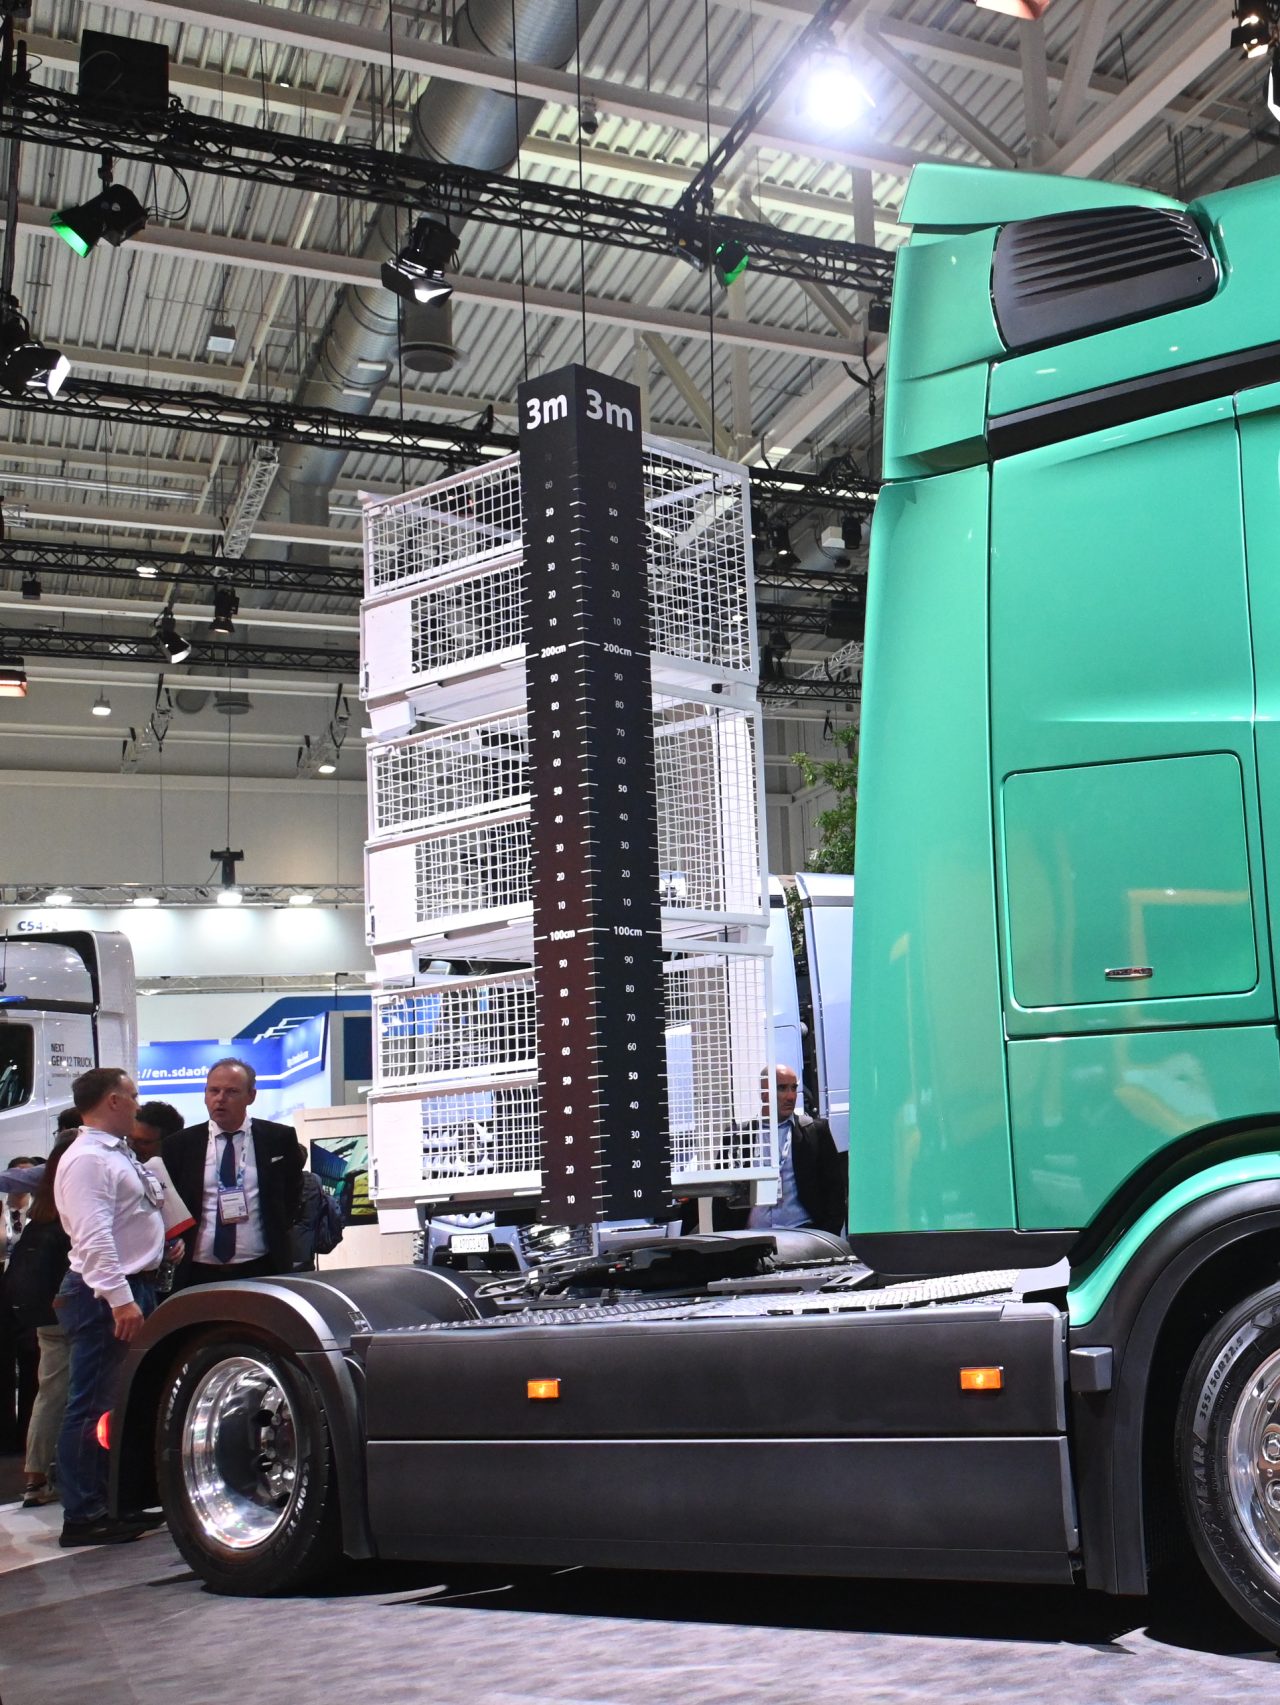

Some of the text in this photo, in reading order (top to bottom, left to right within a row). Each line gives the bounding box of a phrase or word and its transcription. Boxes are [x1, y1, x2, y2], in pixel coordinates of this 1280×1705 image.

[527, 395, 567, 429] 3m
[586, 389, 633, 431] 3m
[545, 507, 555, 518] 50
[608, 507, 618, 517] 50
[546, 534, 555, 544] 40
[609, 535, 619, 544] 40
[547, 562, 556, 572] 30
[610, 561, 620, 572] 30
[547, 589, 557, 600] 20
[611, 589, 621, 599] 20
[548, 617, 558, 627] 10
[612, 617, 622, 627] 10
[541, 645, 566, 658] 200cm
[604, 643, 632, 656] 200cm
[549, 673, 559, 683] 90
[613, 672, 624, 682] 90
[550, 701, 560, 711] 80
[614, 699, 625, 710] 80
[551, 729, 561, 739] 70
[616, 727, 626, 737] 70
[552, 757, 562, 768] 60
[616, 756, 627, 765] 60
[553, 785, 563, 796] 50
[617, 784, 628, 793] 50
[554, 814, 564, 824] 40
[618, 812, 629, 822] 40
[555, 843, 565, 853] 30
[620, 840, 630, 850] 30
[556, 871, 566, 882] 20
[621, 869, 631, 878] 20
[557, 900, 566, 910] 10
[622, 897, 632, 907] 10
[550, 930, 575, 941] 100cm
[614, 926, 642, 936] 100cm
[558, 958, 568, 969] 90
[624, 955, 634, 965] 90
[559, 987, 569, 998] 80
[625, 984, 635, 993] 80
[560, 1017, 570, 1027] 70
[626, 1013, 636, 1022] 70
[561, 1046, 571, 1056] 60
[627, 1042, 637, 1051] 60
[73, 1056, 92, 1068] TRUCK
[562, 1075, 573, 1086] 50
[628, 1071, 639, 1081] 50
[563, 1105, 573, 1115] 40
[629, 1100, 640, 1110] 40
[564, 1135, 574, 1145] 30
[630, 1130, 641, 1140] 30
[631, 1159, 642, 1169] 20
[565, 1164, 575, 1175] 20
[633, 1189, 643, 1198] 10
[566, 1194, 576, 1205] 10
